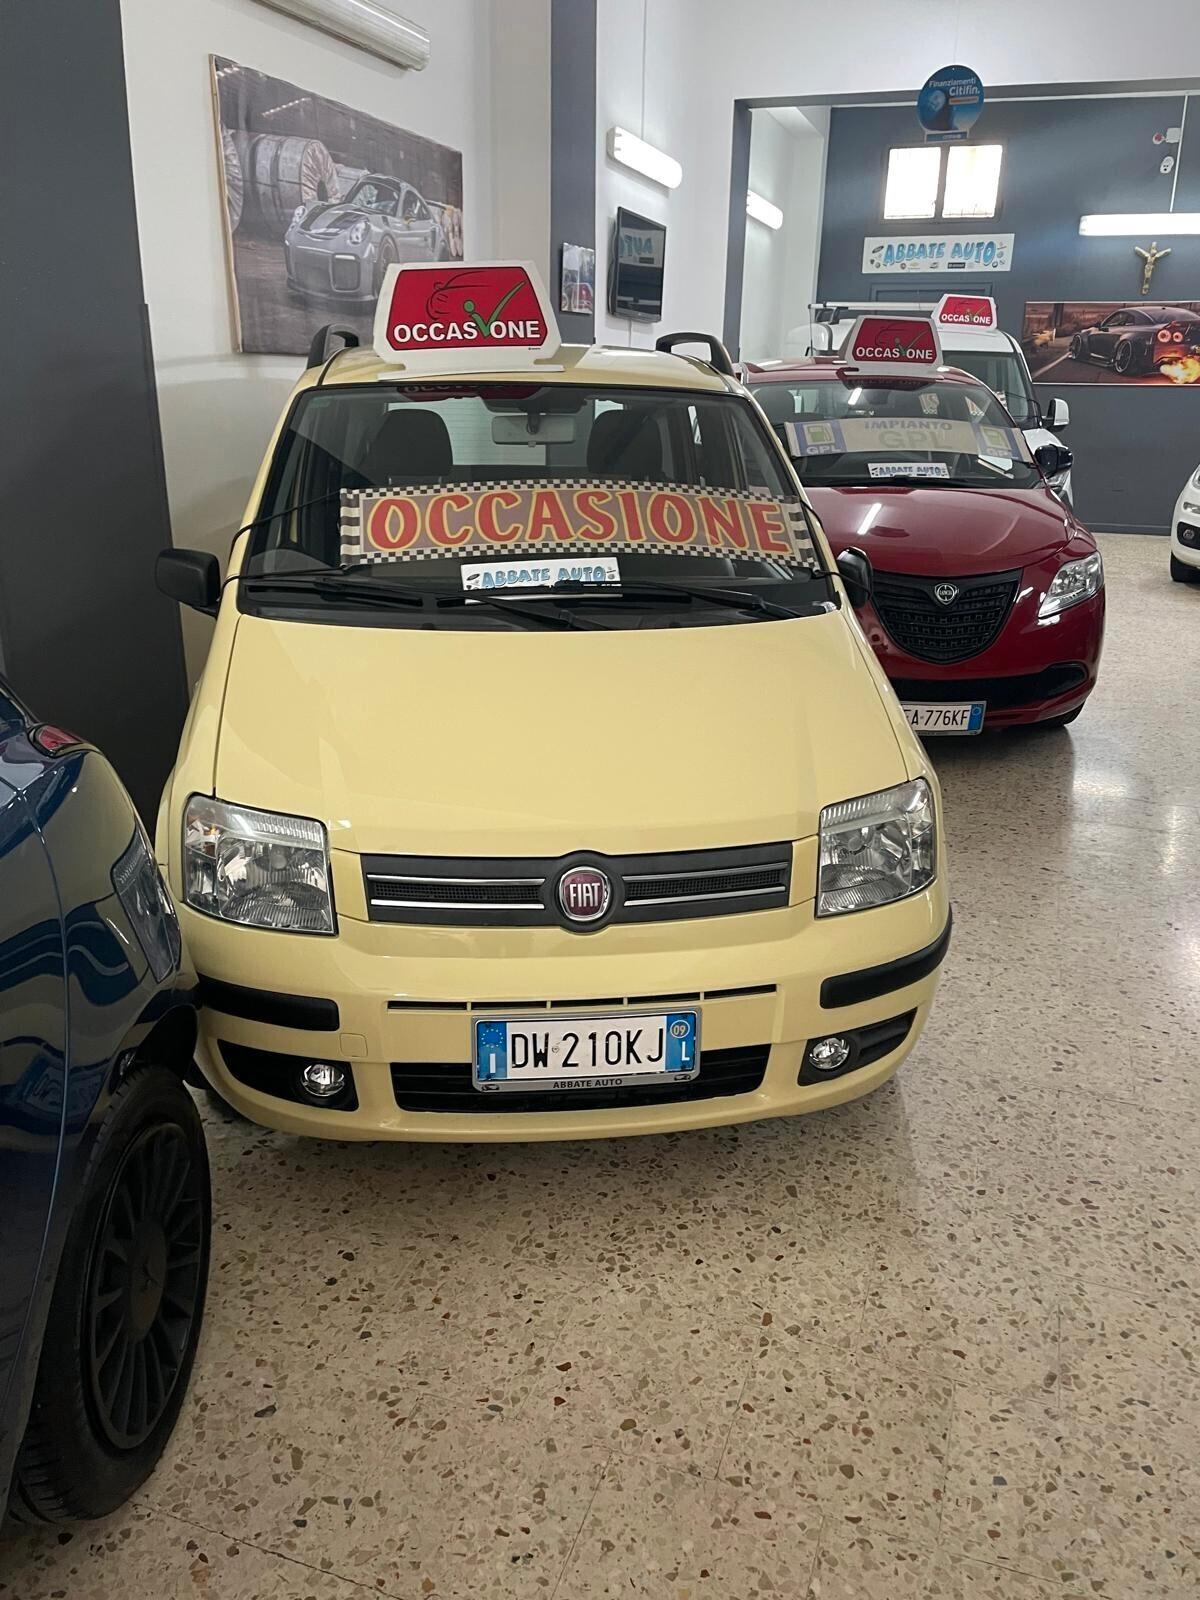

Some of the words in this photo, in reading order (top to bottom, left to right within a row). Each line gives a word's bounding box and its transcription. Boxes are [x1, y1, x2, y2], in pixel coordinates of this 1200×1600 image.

[928, 78, 977, 88] Finanziamenti
[882, 242, 947, 266] ABBATE
[951, 240, 997, 266] AUTO
[864, 420, 953, 430] IMPIANTO
[879, 430, 953, 448] GPL
[806, 446, 841, 455] GPL
[879, 466, 913, 475] ABBATE
[917, 466, 941, 475] AUTO
[367, 488, 796, 554] OCCASIONE
[482, 568, 550, 588] ABBATE
[557, 566, 606, 582] AUTO
[569, 882, 601, 908] FIAT
[673, 1025, 686, 1036] 09
[553, 1080, 592, 1089] ABBATE
[595, 1078, 622, 1087] AUTO
